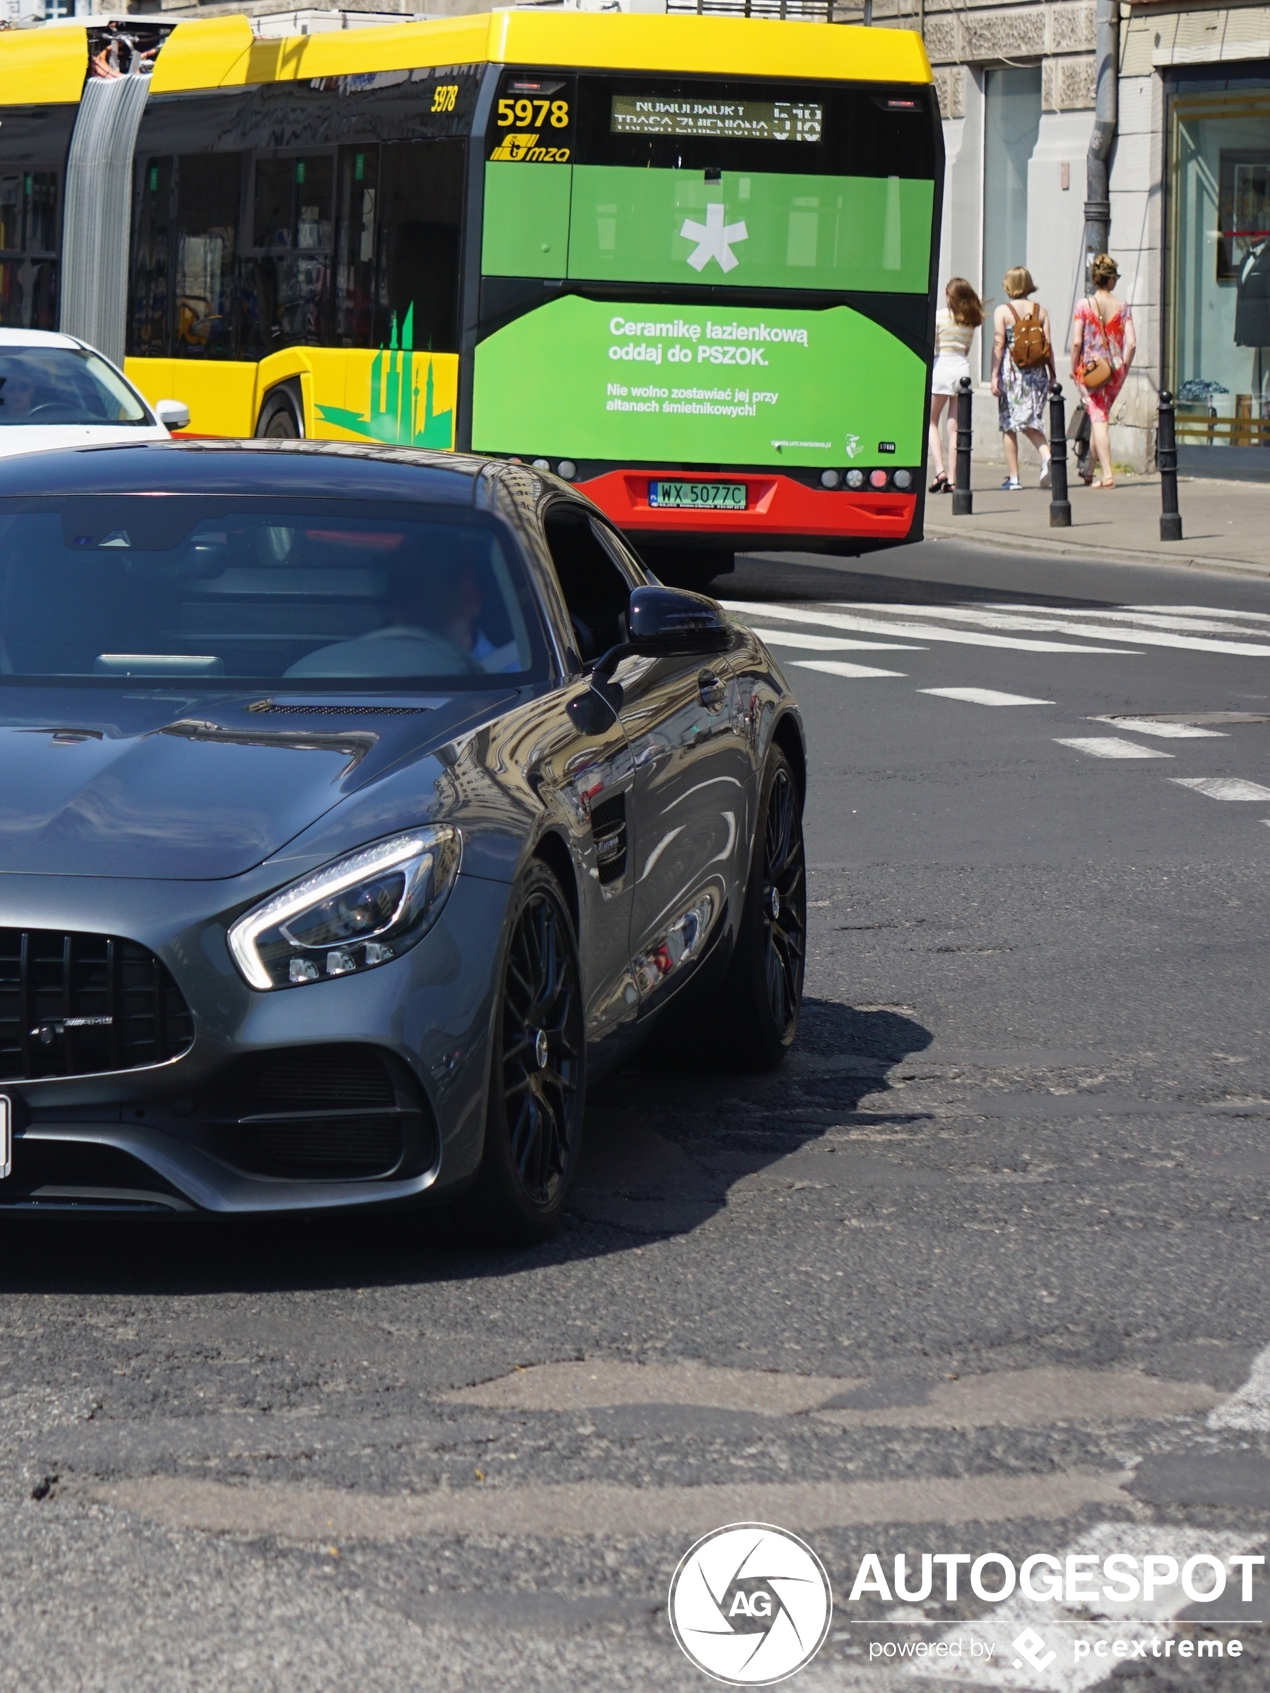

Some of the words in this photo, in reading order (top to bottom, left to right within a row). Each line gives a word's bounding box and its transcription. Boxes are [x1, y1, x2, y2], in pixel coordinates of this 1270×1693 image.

[430, 84, 459, 113] 5978
[496, 98, 570, 128] 5978
[525, 147, 571, 162] mza
[609, 316, 701, 342] Ceramikę
[705, 321, 809, 347] łazienkową
[608, 343, 662, 365] oddaj
[667, 344, 693, 363] do
[697, 345, 769, 366] PSZOK.
[606, 383, 628, 397] Nie
[630, 385, 668, 399] wolno
[671, 387, 732, 401] zostawiać
[733, 388, 750, 403] jej
[752, 390, 778, 405] przy
[662, 401, 756, 418] śmietnikowych!
[661, 484, 684, 503] WX
[690, 485, 742, 504] 5077C
